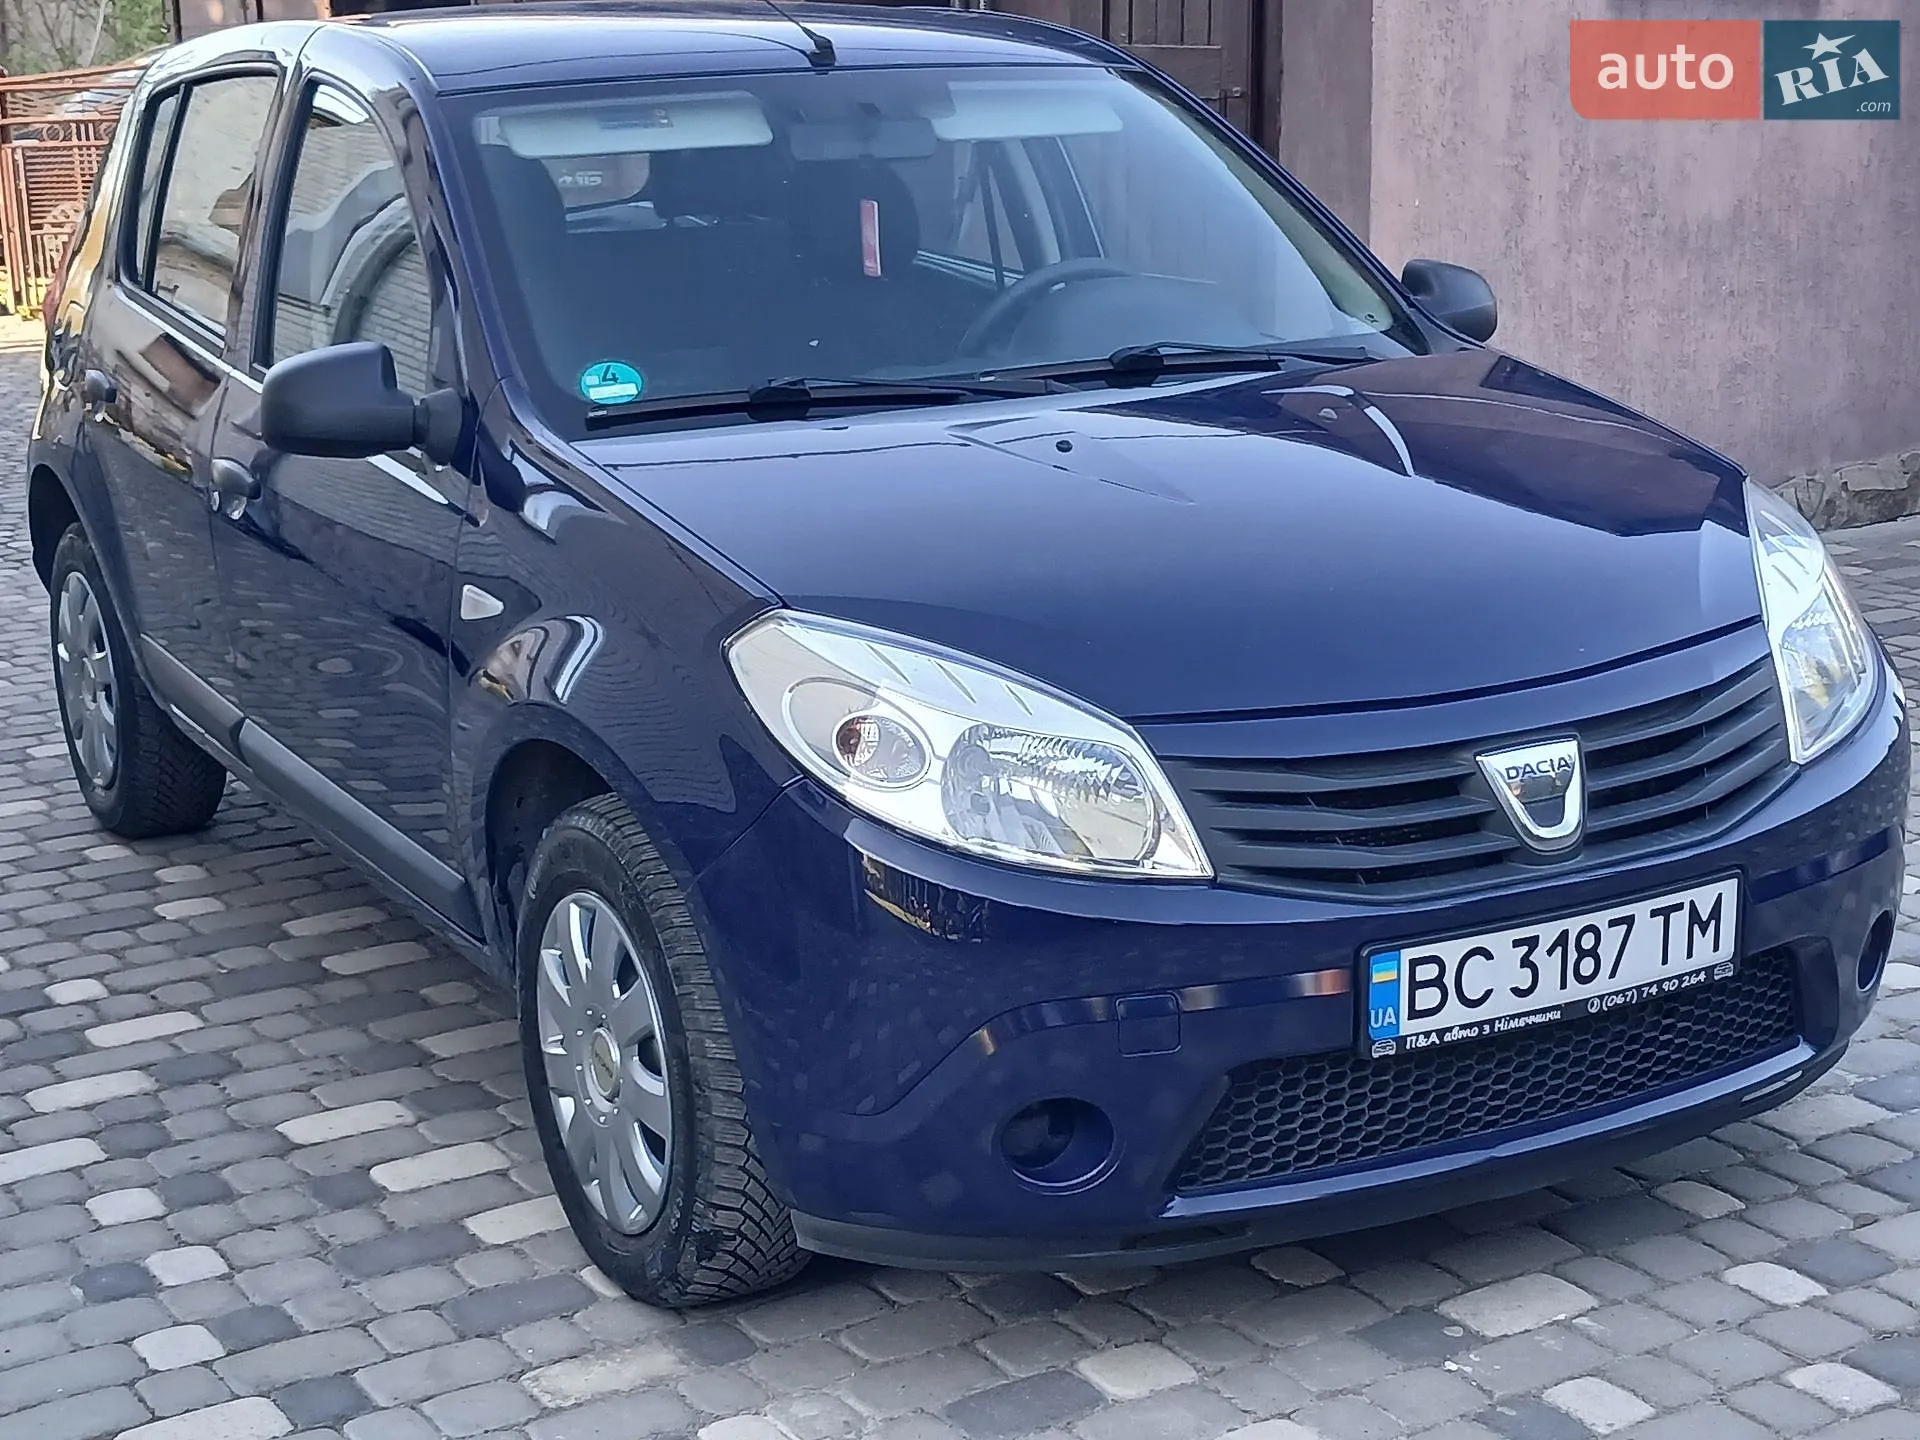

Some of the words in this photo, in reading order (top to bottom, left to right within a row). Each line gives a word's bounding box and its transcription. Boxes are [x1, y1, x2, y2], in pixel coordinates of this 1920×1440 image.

[601, 364, 620, 383] 4
[1505, 756, 1571, 780] DACIA
[1407, 946, 1495, 1021] BC
[1509, 914, 1636, 998] 3187
[1650, 892, 1723, 966] TM
[1602, 988, 1638, 1012] (067)
[1642, 985, 1659, 999] 74
[1662, 978, 1678, 993] 90
[1681, 970, 1706, 989] 264
[1370, 1007, 1397, 1029] UA
[1443, 1025, 1480, 1043] авто
[1494, 1009, 1561, 1034] Німеччини
